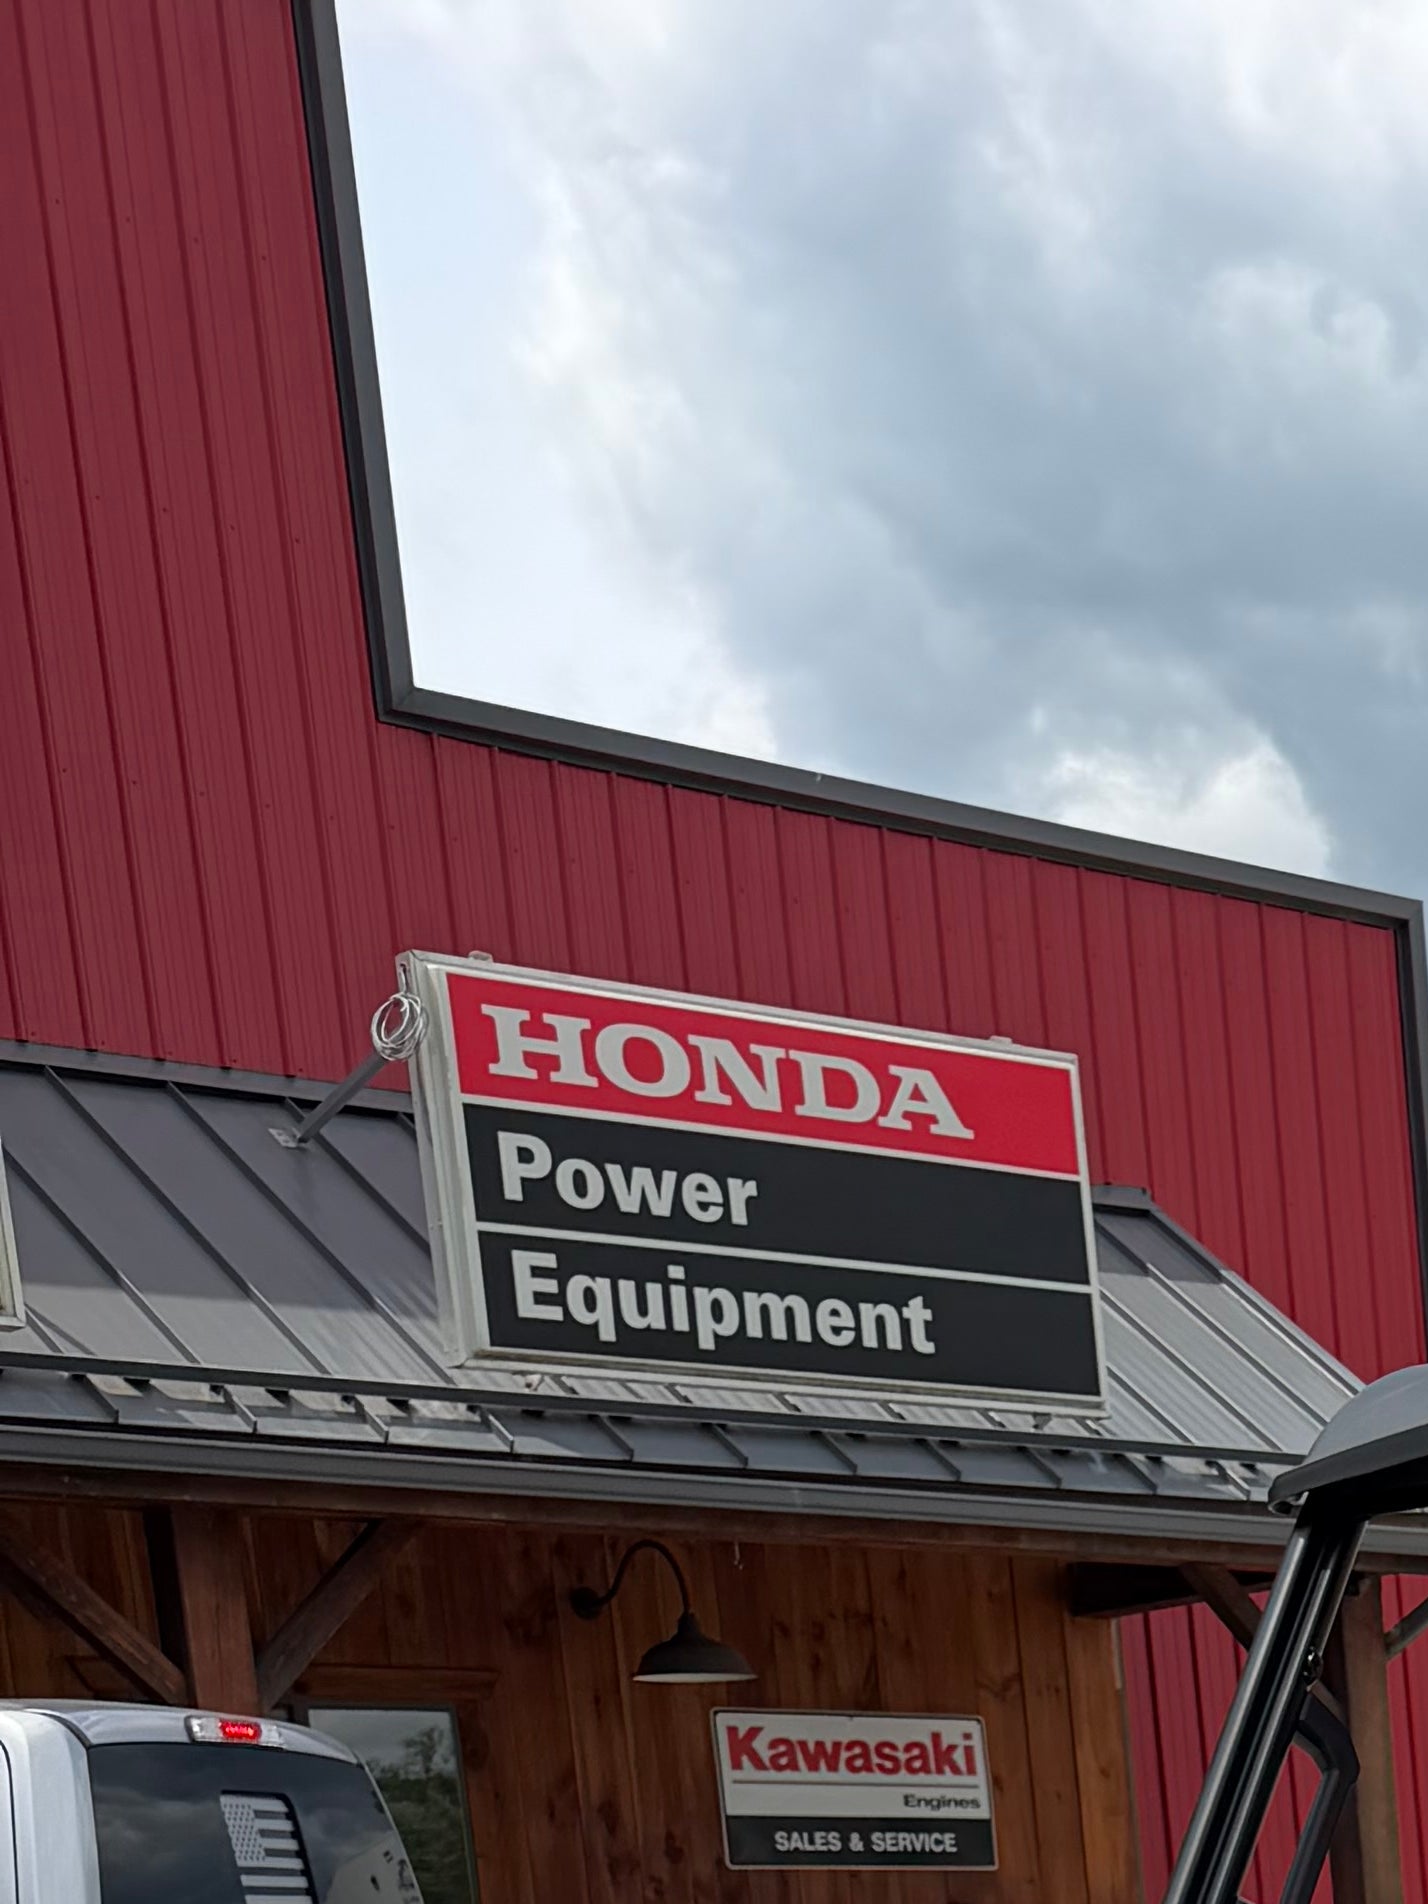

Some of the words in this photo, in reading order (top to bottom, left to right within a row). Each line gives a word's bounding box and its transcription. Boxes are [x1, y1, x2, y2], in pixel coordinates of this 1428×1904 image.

[480, 1003, 975, 1140] HONDA
[497, 1130, 758, 1227] Power
[511, 1249, 936, 1355] Equipment
[725, 1725, 978, 1777] Kawasaki
[903, 1793, 982, 1812] Engines
[774, 1830, 842, 1852] SALES
[849, 1831, 864, 1852] &
[871, 1831, 958, 1853] SERVICE
